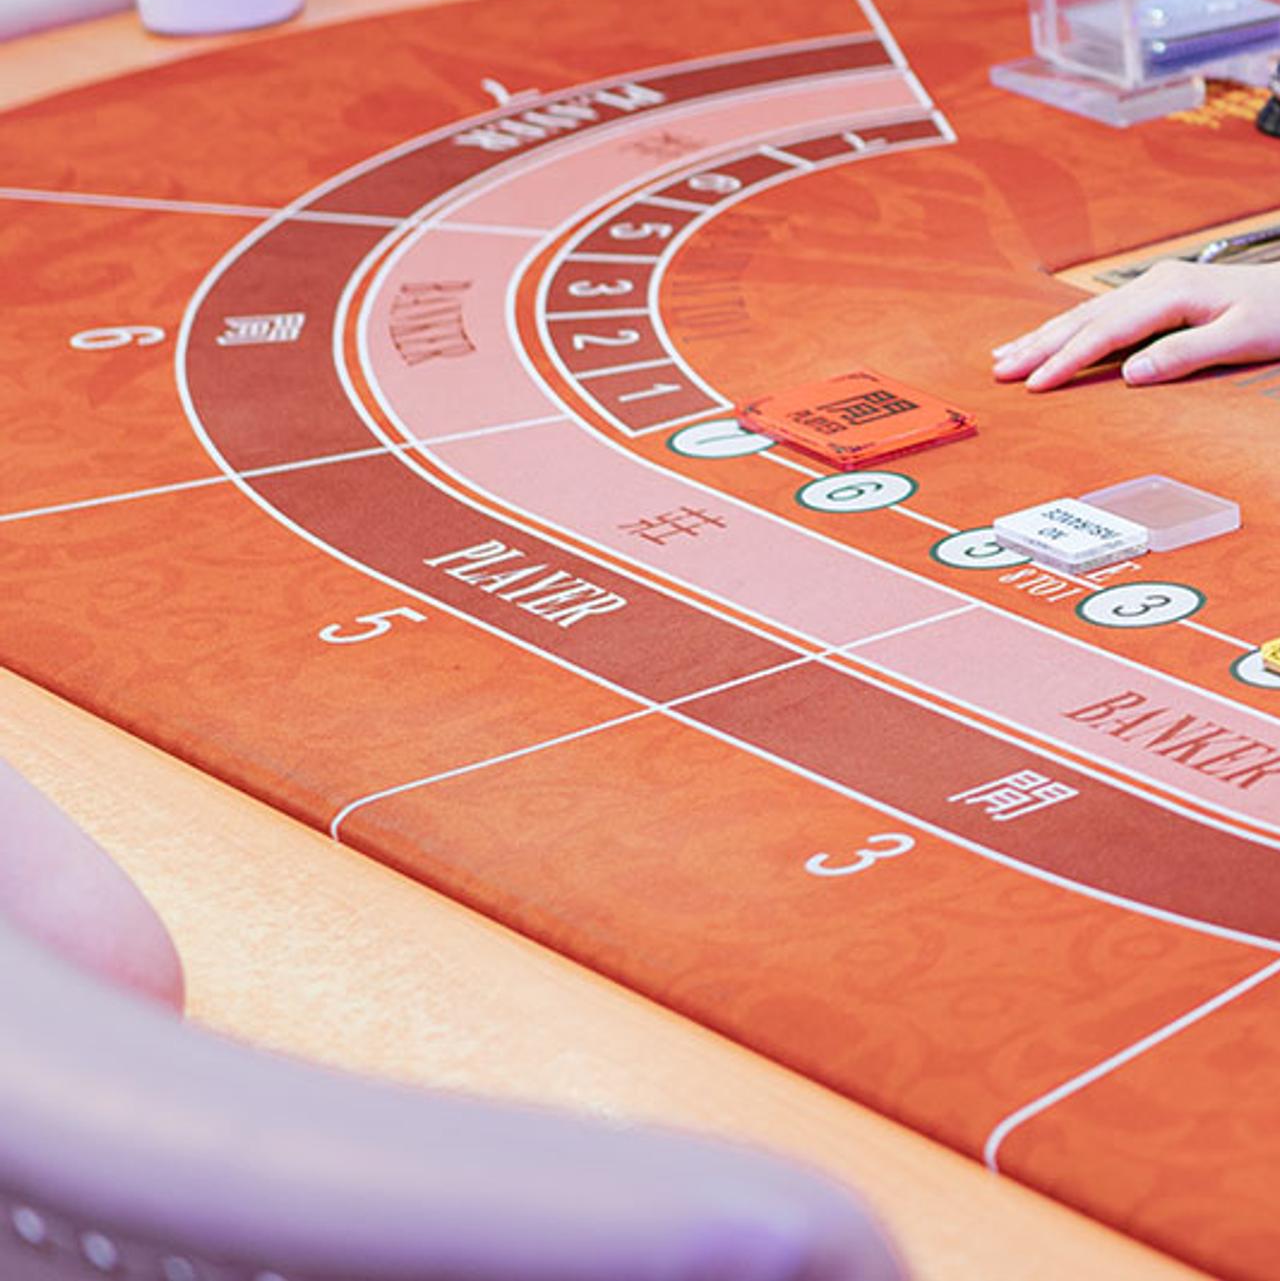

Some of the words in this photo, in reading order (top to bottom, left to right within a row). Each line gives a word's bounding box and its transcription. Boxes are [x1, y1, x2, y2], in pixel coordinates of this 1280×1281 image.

[609, 222, 673, 240] 5
[568, 279, 634, 297] 3
[70, 326, 165, 350] 6
[573, 329, 639, 350] 2
[618, 382, 682, 402] 1
[826, 481, 883, 502] 6
[423, 539, 628, 629] PLAYER
[1112, 594, 1171, 618] 3
[318, 607, 428, 645] 5
[804, 831, 917, 877] 3
